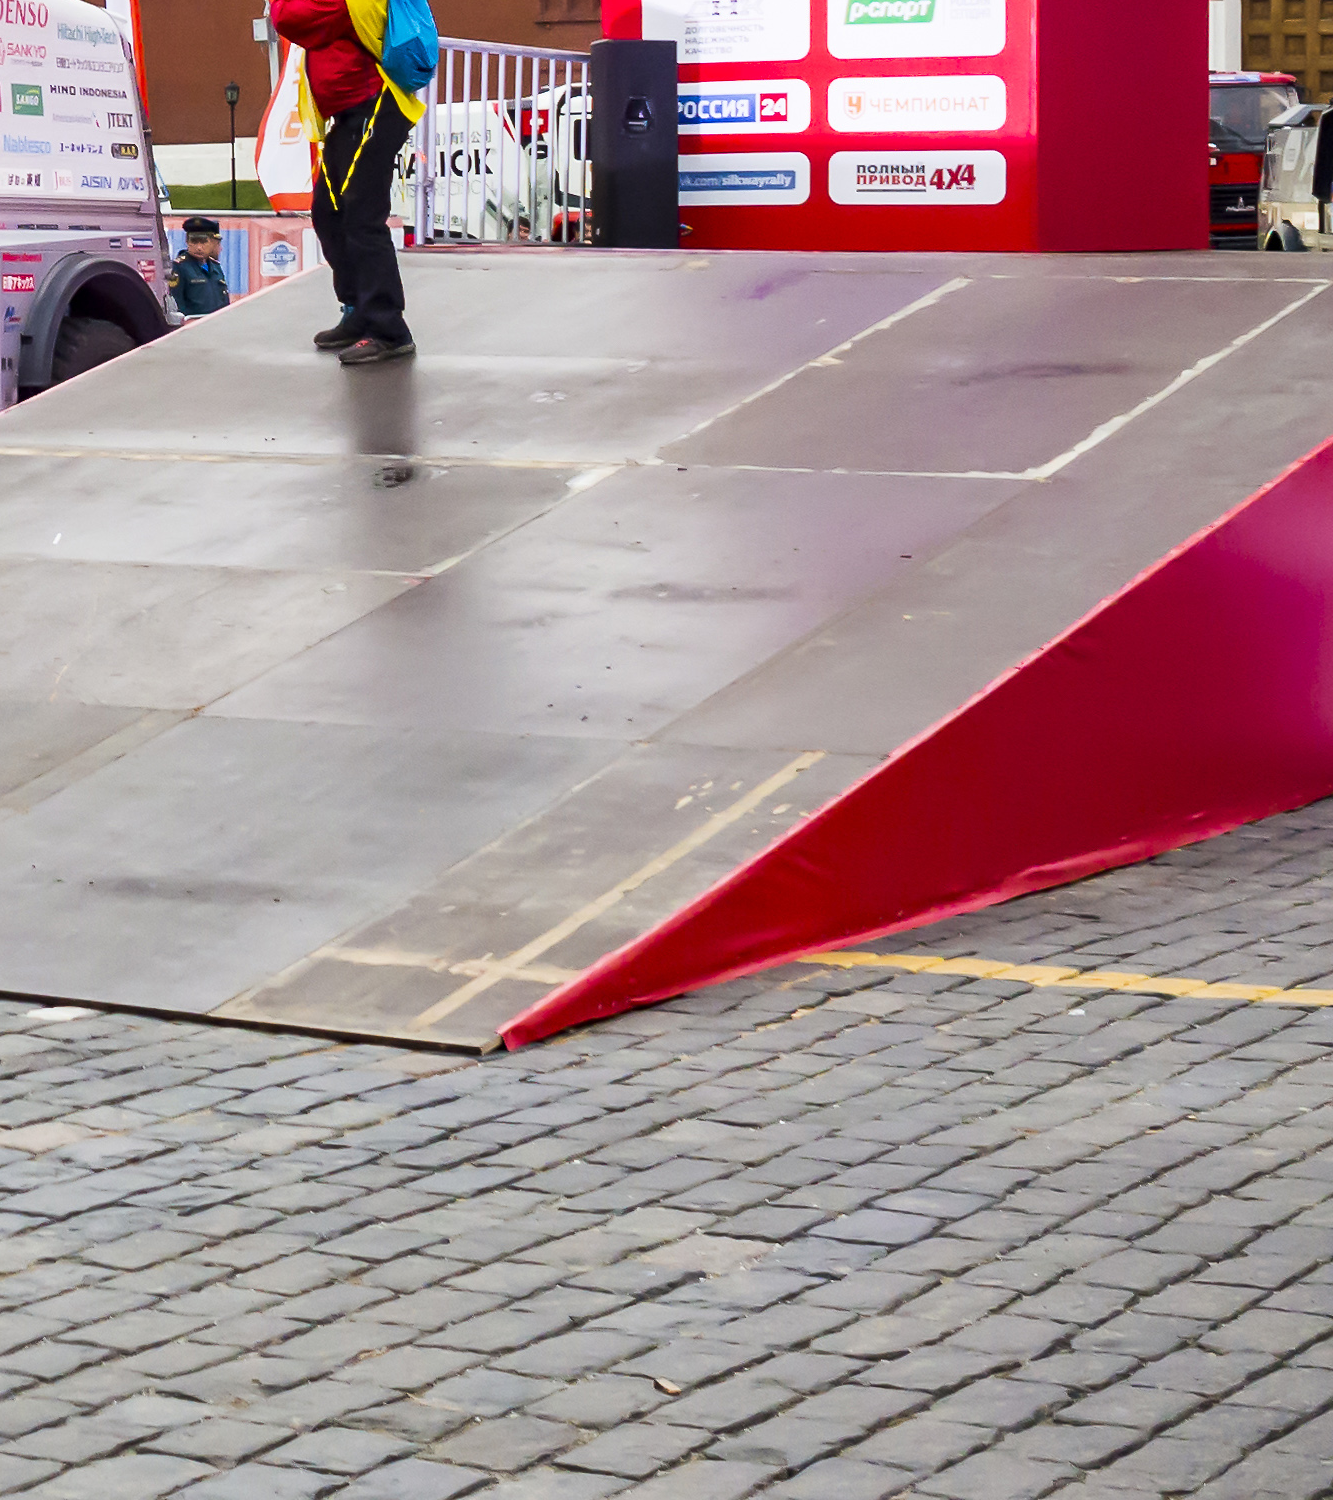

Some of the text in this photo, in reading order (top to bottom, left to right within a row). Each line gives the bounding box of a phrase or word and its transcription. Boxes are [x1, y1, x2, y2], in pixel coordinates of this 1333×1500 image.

[7, 43, 47, 59] SANKYO
[50, 85, 128, 100] HINO INDONESIA
[761, 97, 787, 116] 24
[870, 95, 990, 113] ЧЕМПИОНАТ
[107, 112, 133, 129] JTEKT
[3, 134, 52, 154] Nabtesco
[856, 164, 926, 175] ПОЛНЫЙ
[80, 175, 111, 189] AISIN
[856, 174, 927, 187] ПРИВОД
